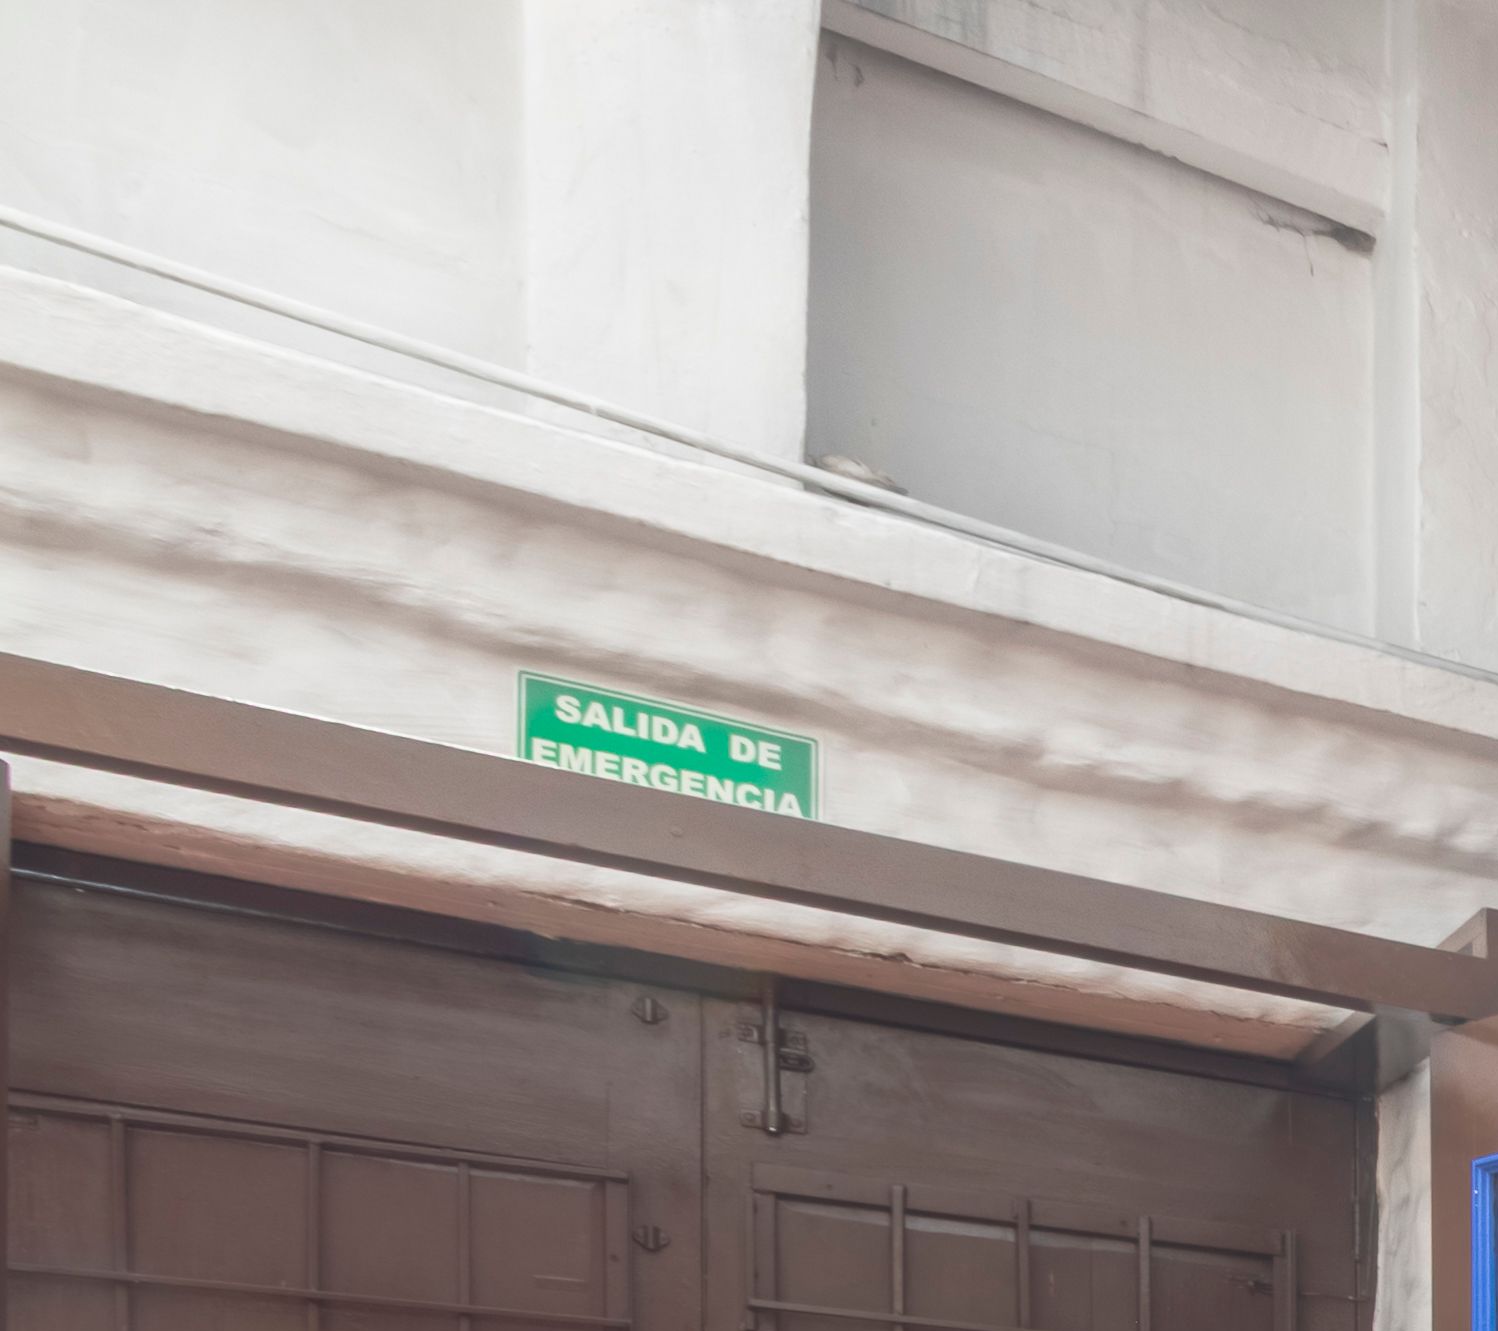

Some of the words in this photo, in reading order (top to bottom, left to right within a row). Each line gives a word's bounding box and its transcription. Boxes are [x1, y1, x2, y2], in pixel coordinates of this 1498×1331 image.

[554, 694, 706, 753] SALIDA
[729, 734, 782, 771] DE
[530, 736, 804, 819] EMERGENCIA
